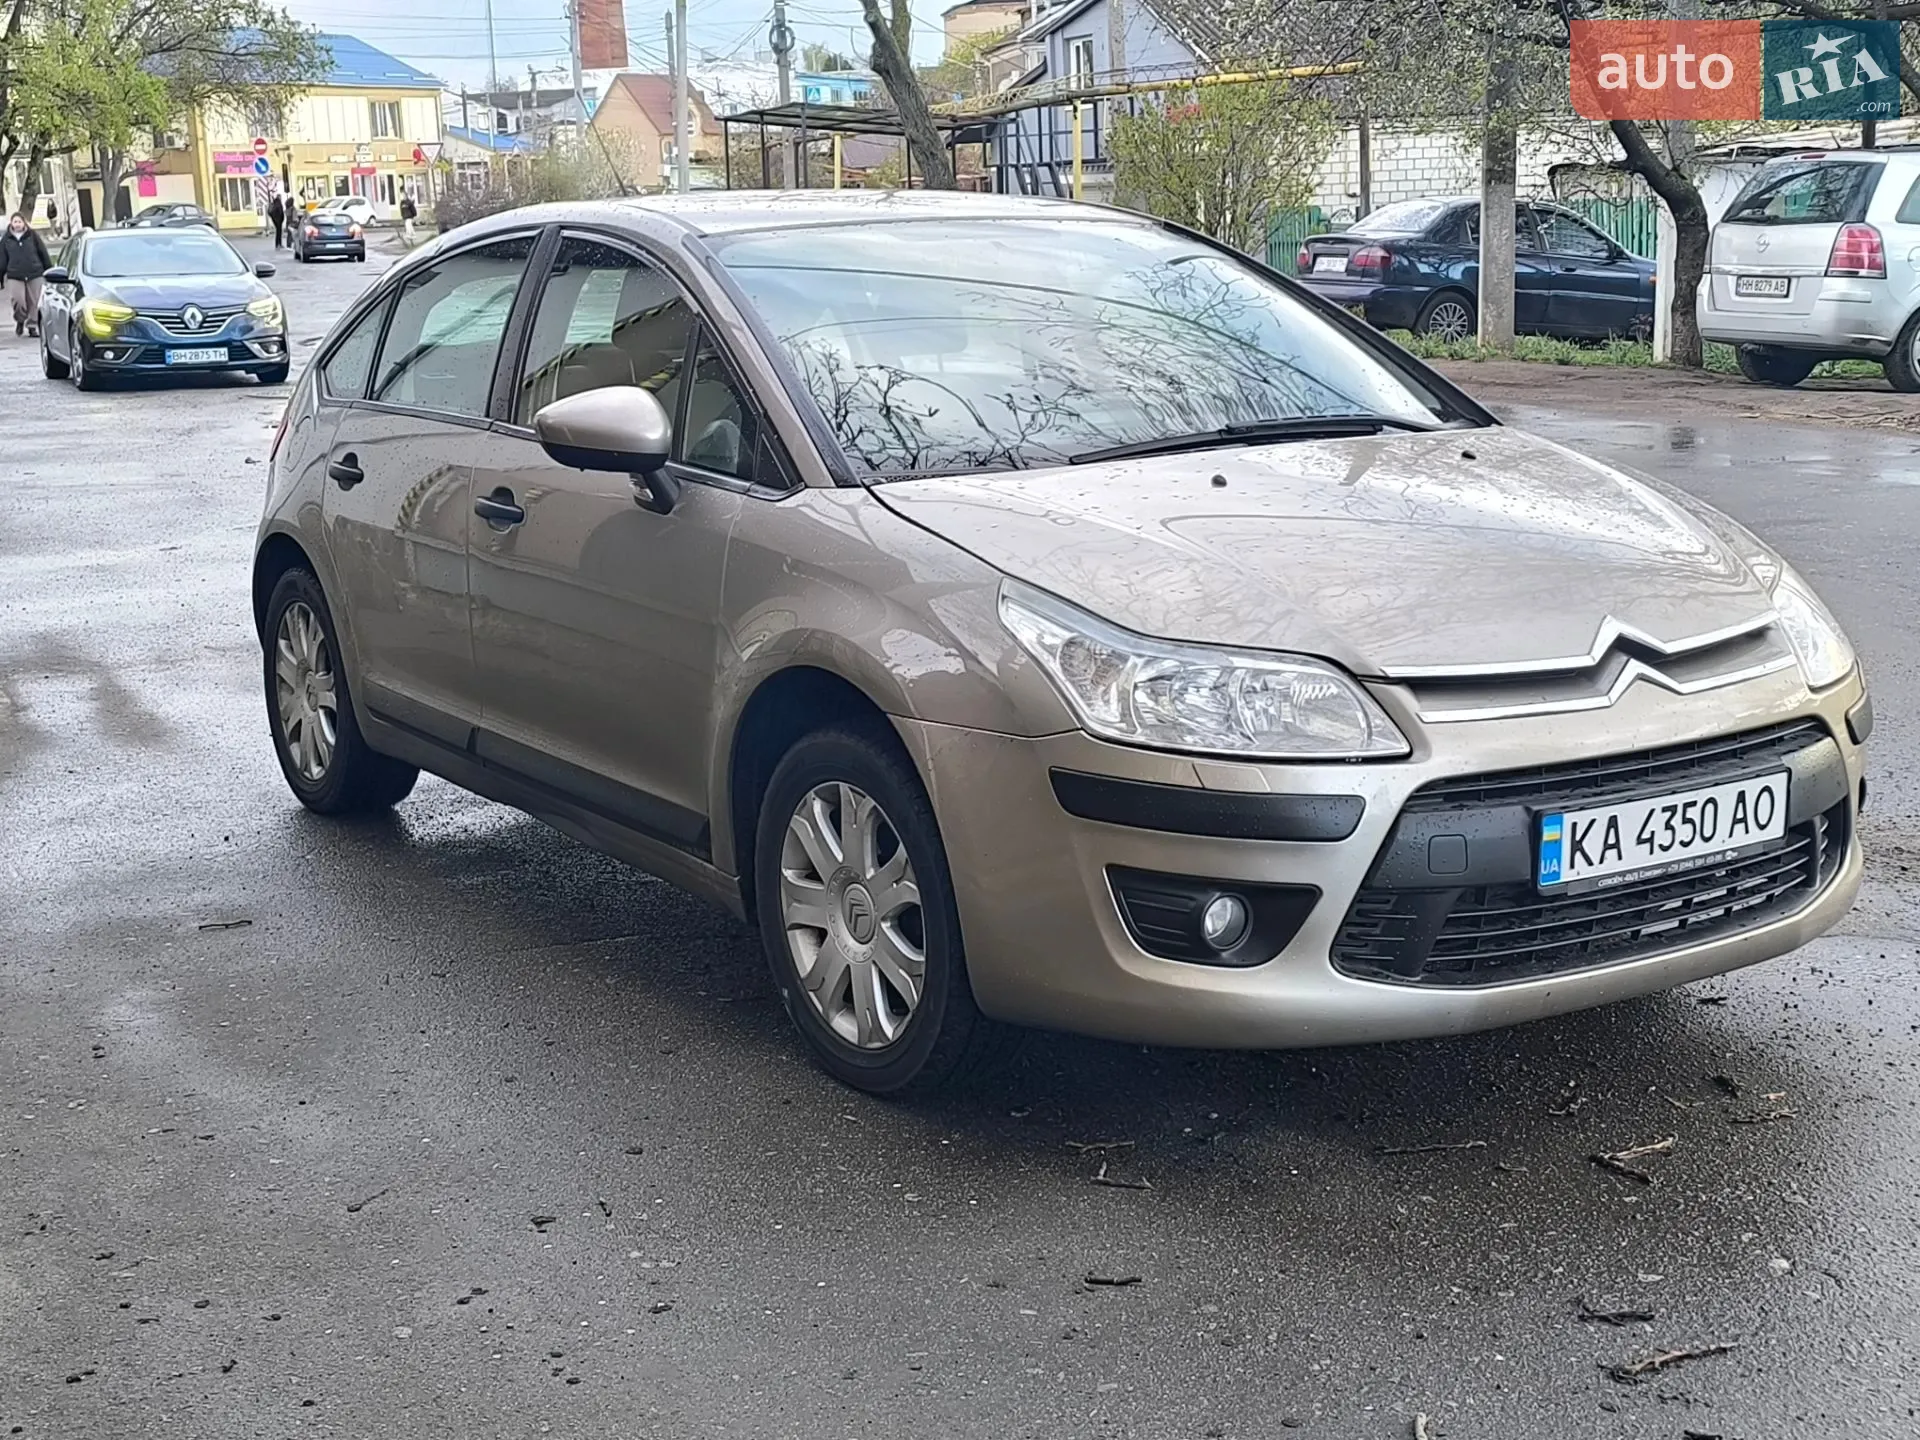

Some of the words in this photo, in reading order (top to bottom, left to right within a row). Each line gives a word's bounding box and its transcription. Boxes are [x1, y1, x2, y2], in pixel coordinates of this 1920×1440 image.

[1754, 279, 1773, 291] 8279
[1774, 280, 1786, 292] AB
[172, 351, 187, 361] BH
[188, 350, 211, 361] 2875
[212, 349, 227, 360] TH
[1569, 814, 1623, 870] KA
[1636, 796, 1719, 856] 4350
[1728, 785, 1775, 839] AO
[1540, 858, 1560, 875] UA
